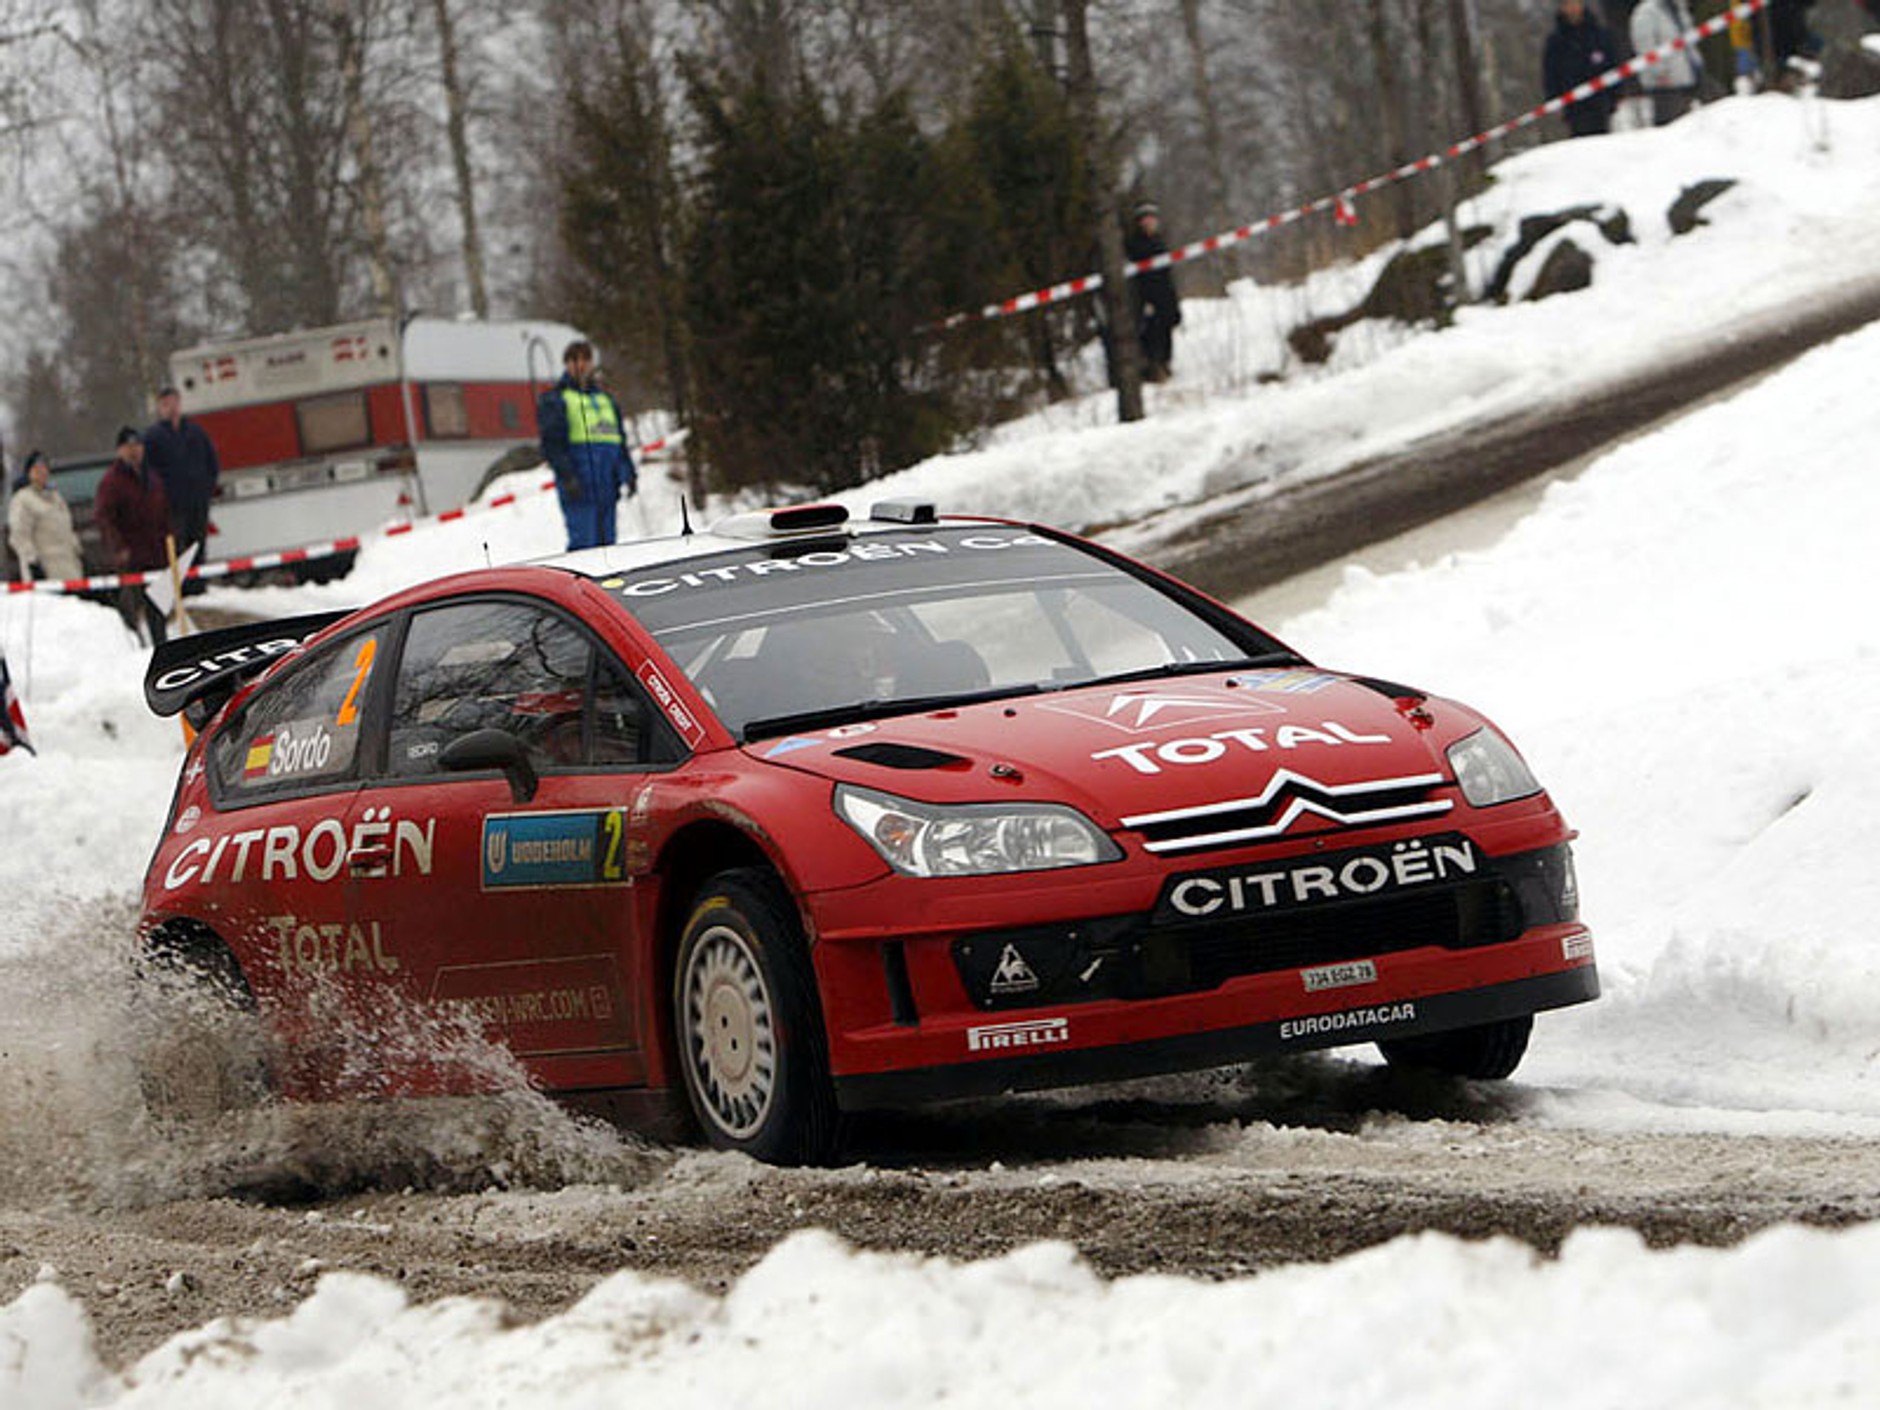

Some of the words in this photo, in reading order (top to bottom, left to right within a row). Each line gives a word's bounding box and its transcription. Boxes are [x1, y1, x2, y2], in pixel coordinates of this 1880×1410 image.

[622, 541, 949, 597] CITROËN
[336, 639, 377, 726] 2
[271, 725, 331, 775] Sordo
[1091, 721, 1392, 774] TOTAL
[164, 806, 436, 890] CITROËN
[604, 811, 623, 879] 2
[1170, 839, 1476, 916] CITROËN
[266, 915, 400, 982] TOTAL
[967, 1018, 1069, 1051] PIRELLI
[1279, 1002, 1416, 1039] EURODATACAR
